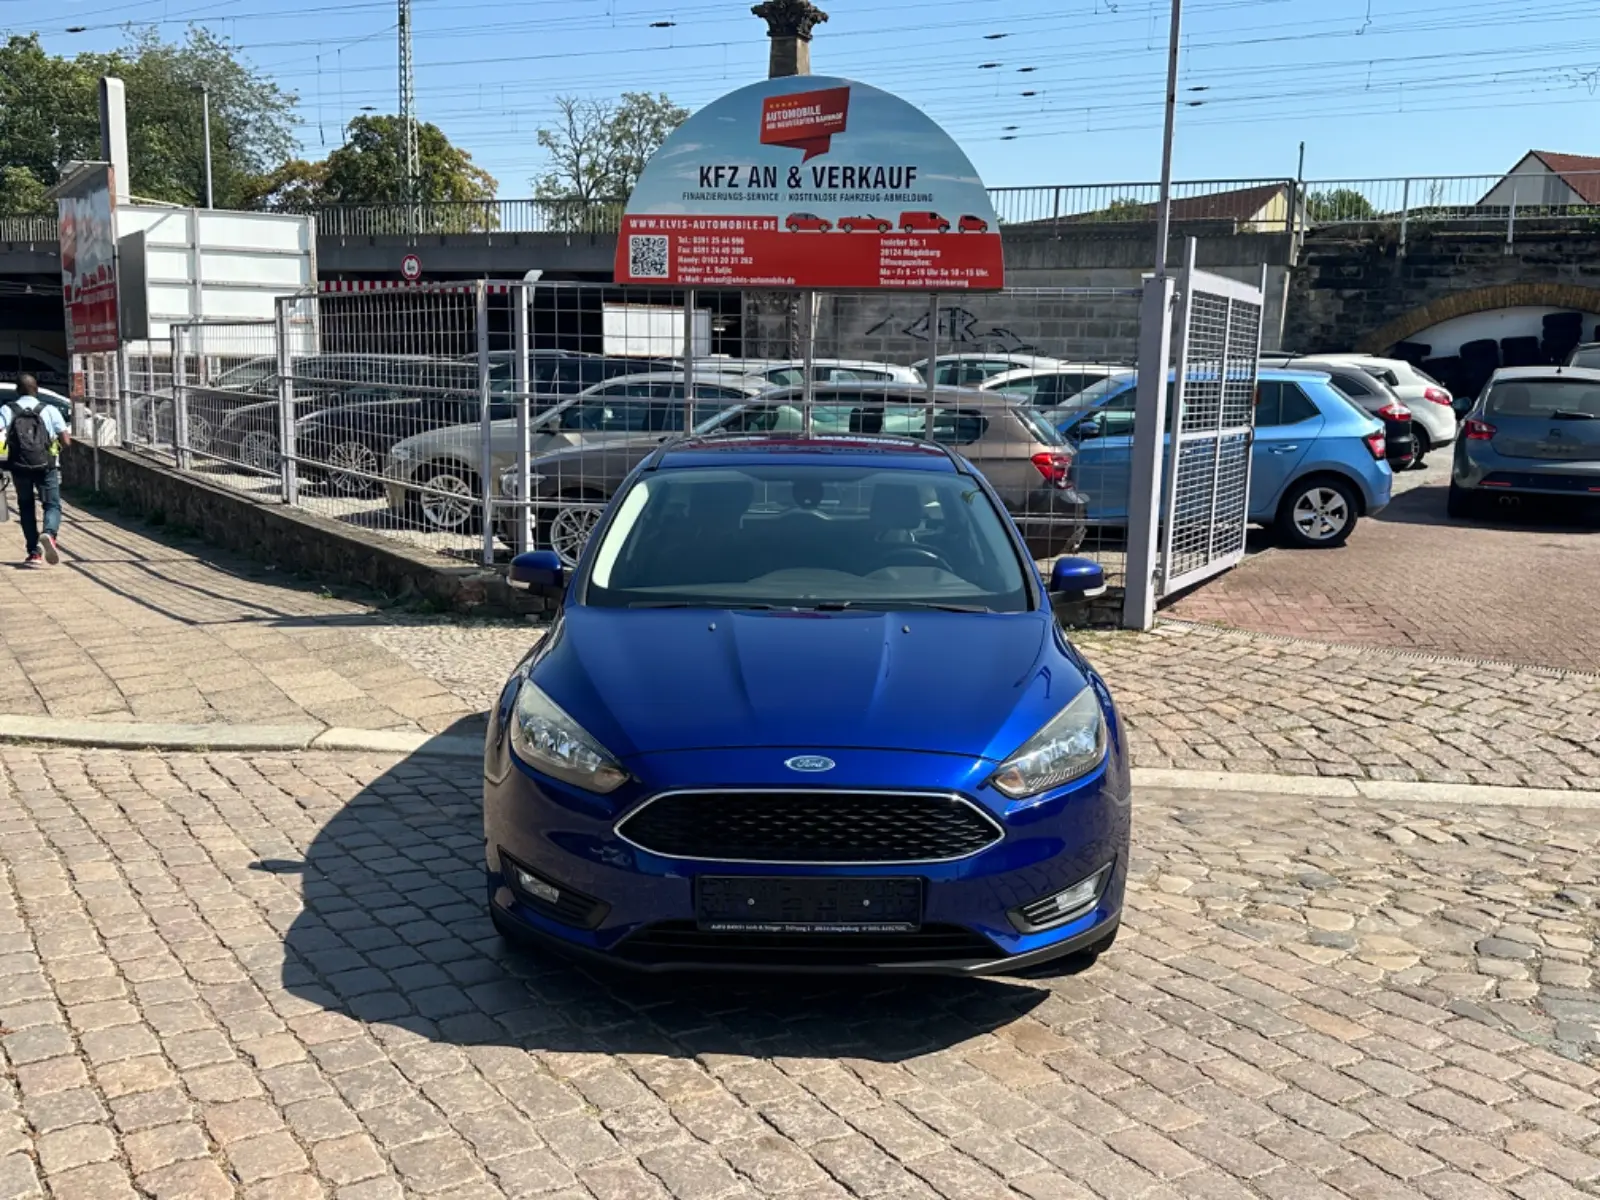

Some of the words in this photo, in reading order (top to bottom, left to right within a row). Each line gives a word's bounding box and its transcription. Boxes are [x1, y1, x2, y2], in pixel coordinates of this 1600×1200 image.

[766, 104, 821, 121] AUTOMOBILE
[699, 165, 739, 188] KFZ
[747, 165, 777, 188] AN
[786, 165, 803, 189] &
[812, 166, 917, 189] VERKAUF
[682, 191, 779, 201] FINANZIERUNGS-SERVICE
[788, 193, 837, 202] KOSTENLOSE
[840, 193, 933, 202] FAHRZEUG-ABMELDUNG
[629, 218, 777, 230] WWW.ELVIS-AUTOMOBILE.DE
[903, 249, 941, 259] Magdeburg
[796, 758, 824, 768] Ford
